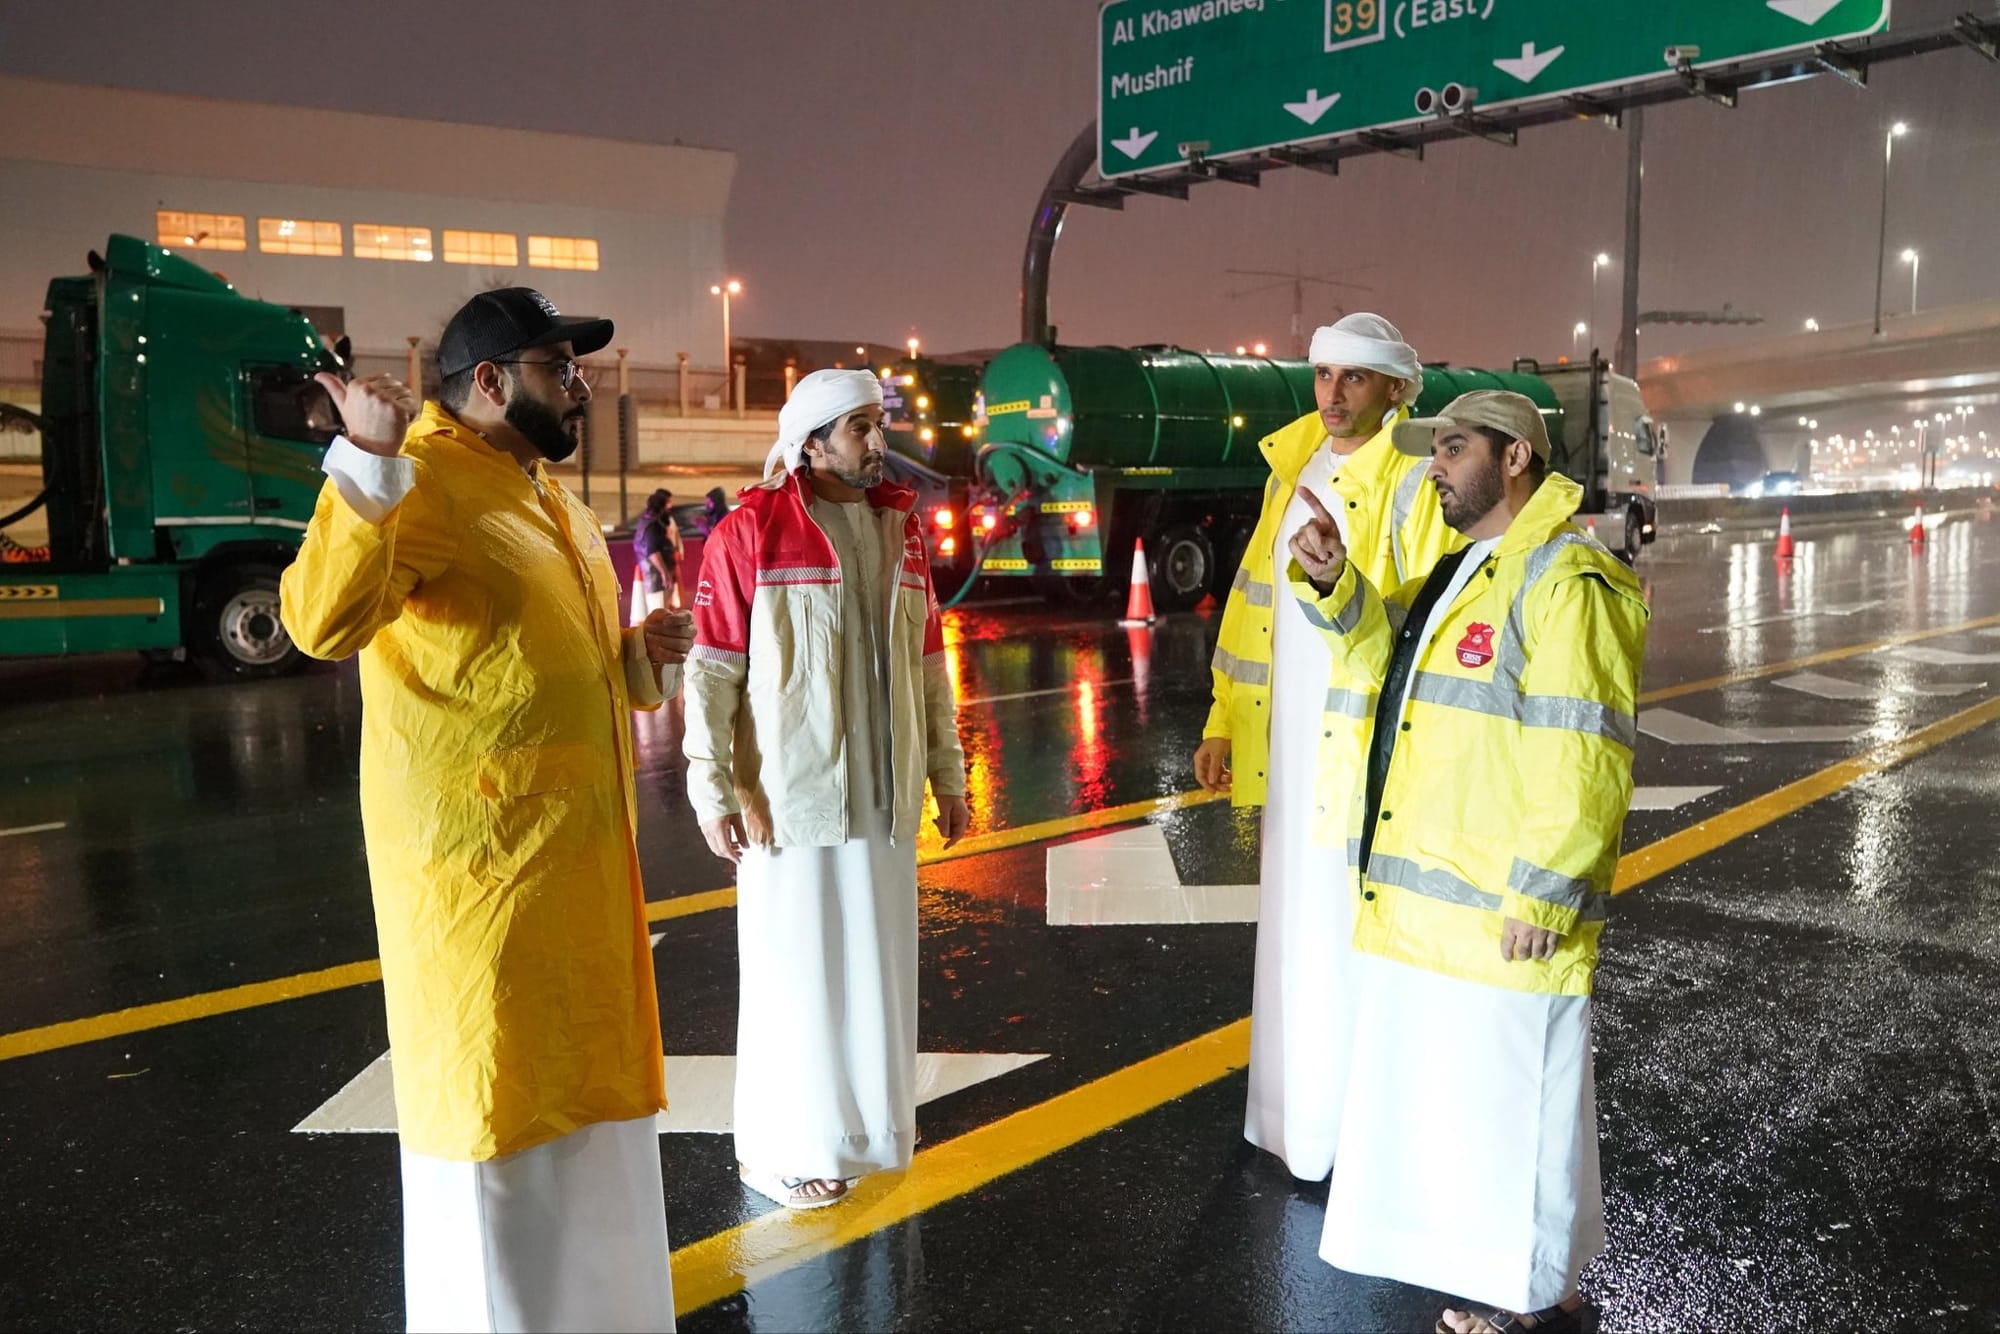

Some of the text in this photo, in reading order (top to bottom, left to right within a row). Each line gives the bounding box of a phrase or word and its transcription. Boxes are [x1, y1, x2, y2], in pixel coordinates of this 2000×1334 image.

[1112, 18, 1135, 46] Al
[1333, 0, 1494, 38] 39 (East)
[1111, 56, 1194, 99] Mushrif
